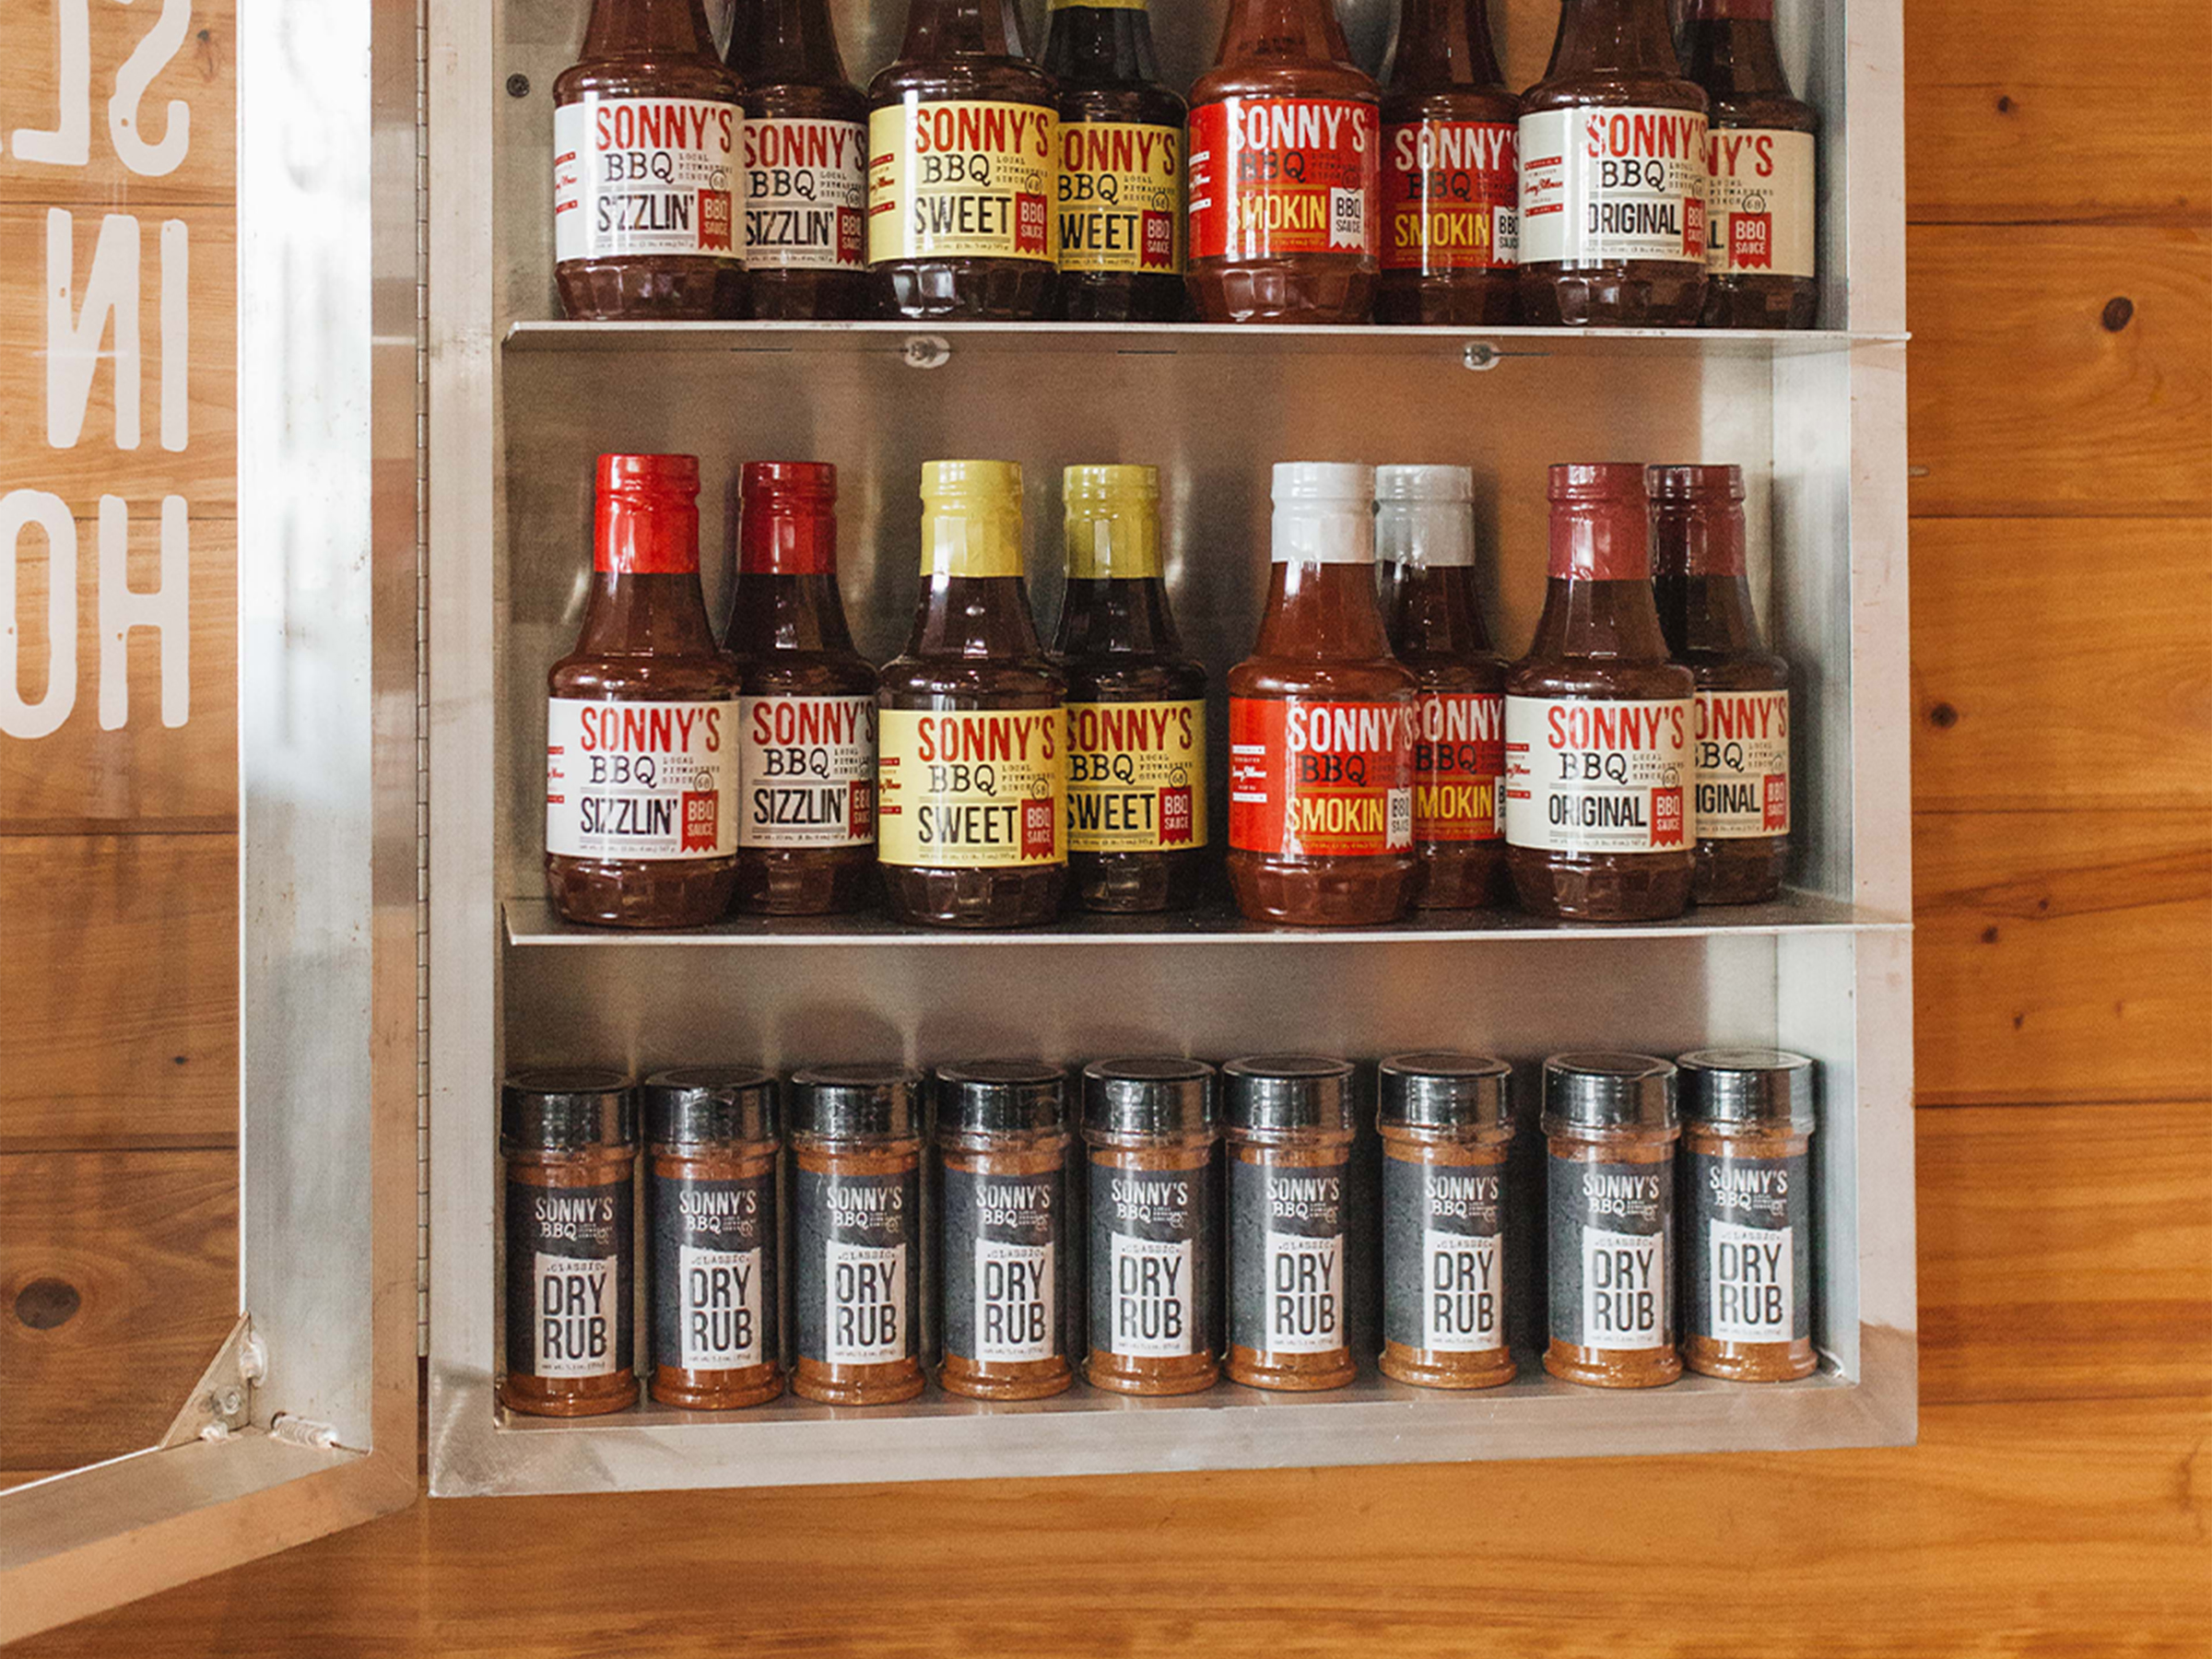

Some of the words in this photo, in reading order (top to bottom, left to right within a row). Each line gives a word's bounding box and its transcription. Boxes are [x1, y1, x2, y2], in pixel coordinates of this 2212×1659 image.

[596, 105, 733, 153] SONNY'S
[916, 108, 1048, 157] SONNY'S
[1586, 114, 1708, 162] SONNY'S
[745, 124, 865, 172] SONNY'S
[1059, 129, 1174, 176] ONNY'S
[605, 151, 674, 183] BBQ
[923, 154, 991, 187] BBQ
[1240, 151, 1306, 183] BBQ
[1596, 160, 1665, 192] BBQ
[748, 170, 817, 201] BBQ
[1058, 174, 1118, 205] BBQ
[1406, 171, 1472, 202] BBQ
[598, 194, 694, 231] SZZLIN'
[704, 199, 727, 219] BBQ
[915, 196, 1012, 234] SWEET
[1021, 202, 1043, 223] BBQ
[1336, 197, 1360, 218] BBQ
[1589, 204, 1681, 234] ORIGINAL
[746, 210, 833, 246] SIZZLIN'
[1147, 218, 1170, 239] BBQ
[1394, 213, 1489, 246] SMOKIN
[1735, 220, 1766, 241] BBQ
[1735, 241, 1766, 254] SAUCE
[581, 707, 720, 752] SONNY'S
[753, 700, 874, 746] SONNY'S
[918, 715, 1054, 761] SONNY'S
[1287, 707, 1413, 752] SONNY'S
[1548, 706, 1684, 749] SONNY'S
[589, 755, 657, 788] BBQ
[763, 747, 830, 779] BBQ
[1069, 754, 1135, 784] BBQ
[1299, 755, 1366, 787] BBQ
[1416, 744, 1477, 774] BBQ
[1559, 753, 1628, 784] BBQ
[1696, 742, 1744, 772] BQ
[928, 764, 997, 796] BBQ
[688, 800, 714, 821] BBQ
[754, 788, 846, 824] SIZZLIN'
[1028, 807, 1051, 829] BBQ
[1164, 795, 1188, 815] BBQ
[1287, 798, 1383, 832] SMOKIN
[1549, 794, 1647, 827] ORIGINAL
[1657, 796, 1679, 817] BBQ
[688, 822, 713, 837] SAUCE
[919, 806, 1018, 843] SWEET
[1112, 1178, 1188, 1206] SONNY'S
[1266, 1177, 1340, 1202] SONNY'S
[1425, 1176, 1499, 1201] SONNY'S
[1583, 1173, 1659, 1199] SONNY'S
[1710, 1165, 1788, 1194] SONNY'S
[535, 1197, 613, 1222] SONNY'S
[679, 1190, 757, 1216] SONNY'S
[827, 1186, 902, 1211] SONNY'S
[976, 1184, 1051, 1209] SONNY'S
[1272, 1202, 1309, 1220] BBQ
[1432, 1200, 1468, 1218] BBQ
[1588, 1198, 1626, 1218] BBQ
[1714, 1191, 1751, 1211] BBQ
[686, 1215, 721, 1234] BBQ
[833, 1211, 869, 1230] BBQ
[982, 1209, 1018, 1228] BBQ
[1116, 1203, 1151, 1223] BBQ
[540, 1222, 577, 1241] BBQ
[550, 1262, 600, 1272] CLASSIC
[1120, 1255, 1182, 1296] DRY
[1276, 1251, 1335, 1293] DRY
[1434, 1250, 1493, 1291] DRY
[1593, 1249, 1653, 1289] DRY
[1720, 1242, 1782, 1283] DRY
[543, 1273, 606, 1316] DRY
[690, 1265, 751, 1308] DRY
[836, 1261, 897, 1303] DRY
[984, 1259, 1045, 1301] DRY
[1120, 1297, 1182, 1339] RUB
[1276, 1294, 1335, 1335] RUB
[1434, 1293, 1493, 1334] RUB
[1594, 1291, 1653, 1332] RUB
[1720, 1283, 1783, 1324] RUB
[543, 1316, 607, 1359] RUB
[690, 1308, 752, 1351] RUB
[836, 1304, 897, 1347] RUB
[984, 1302, 1046, 1344] RUB
